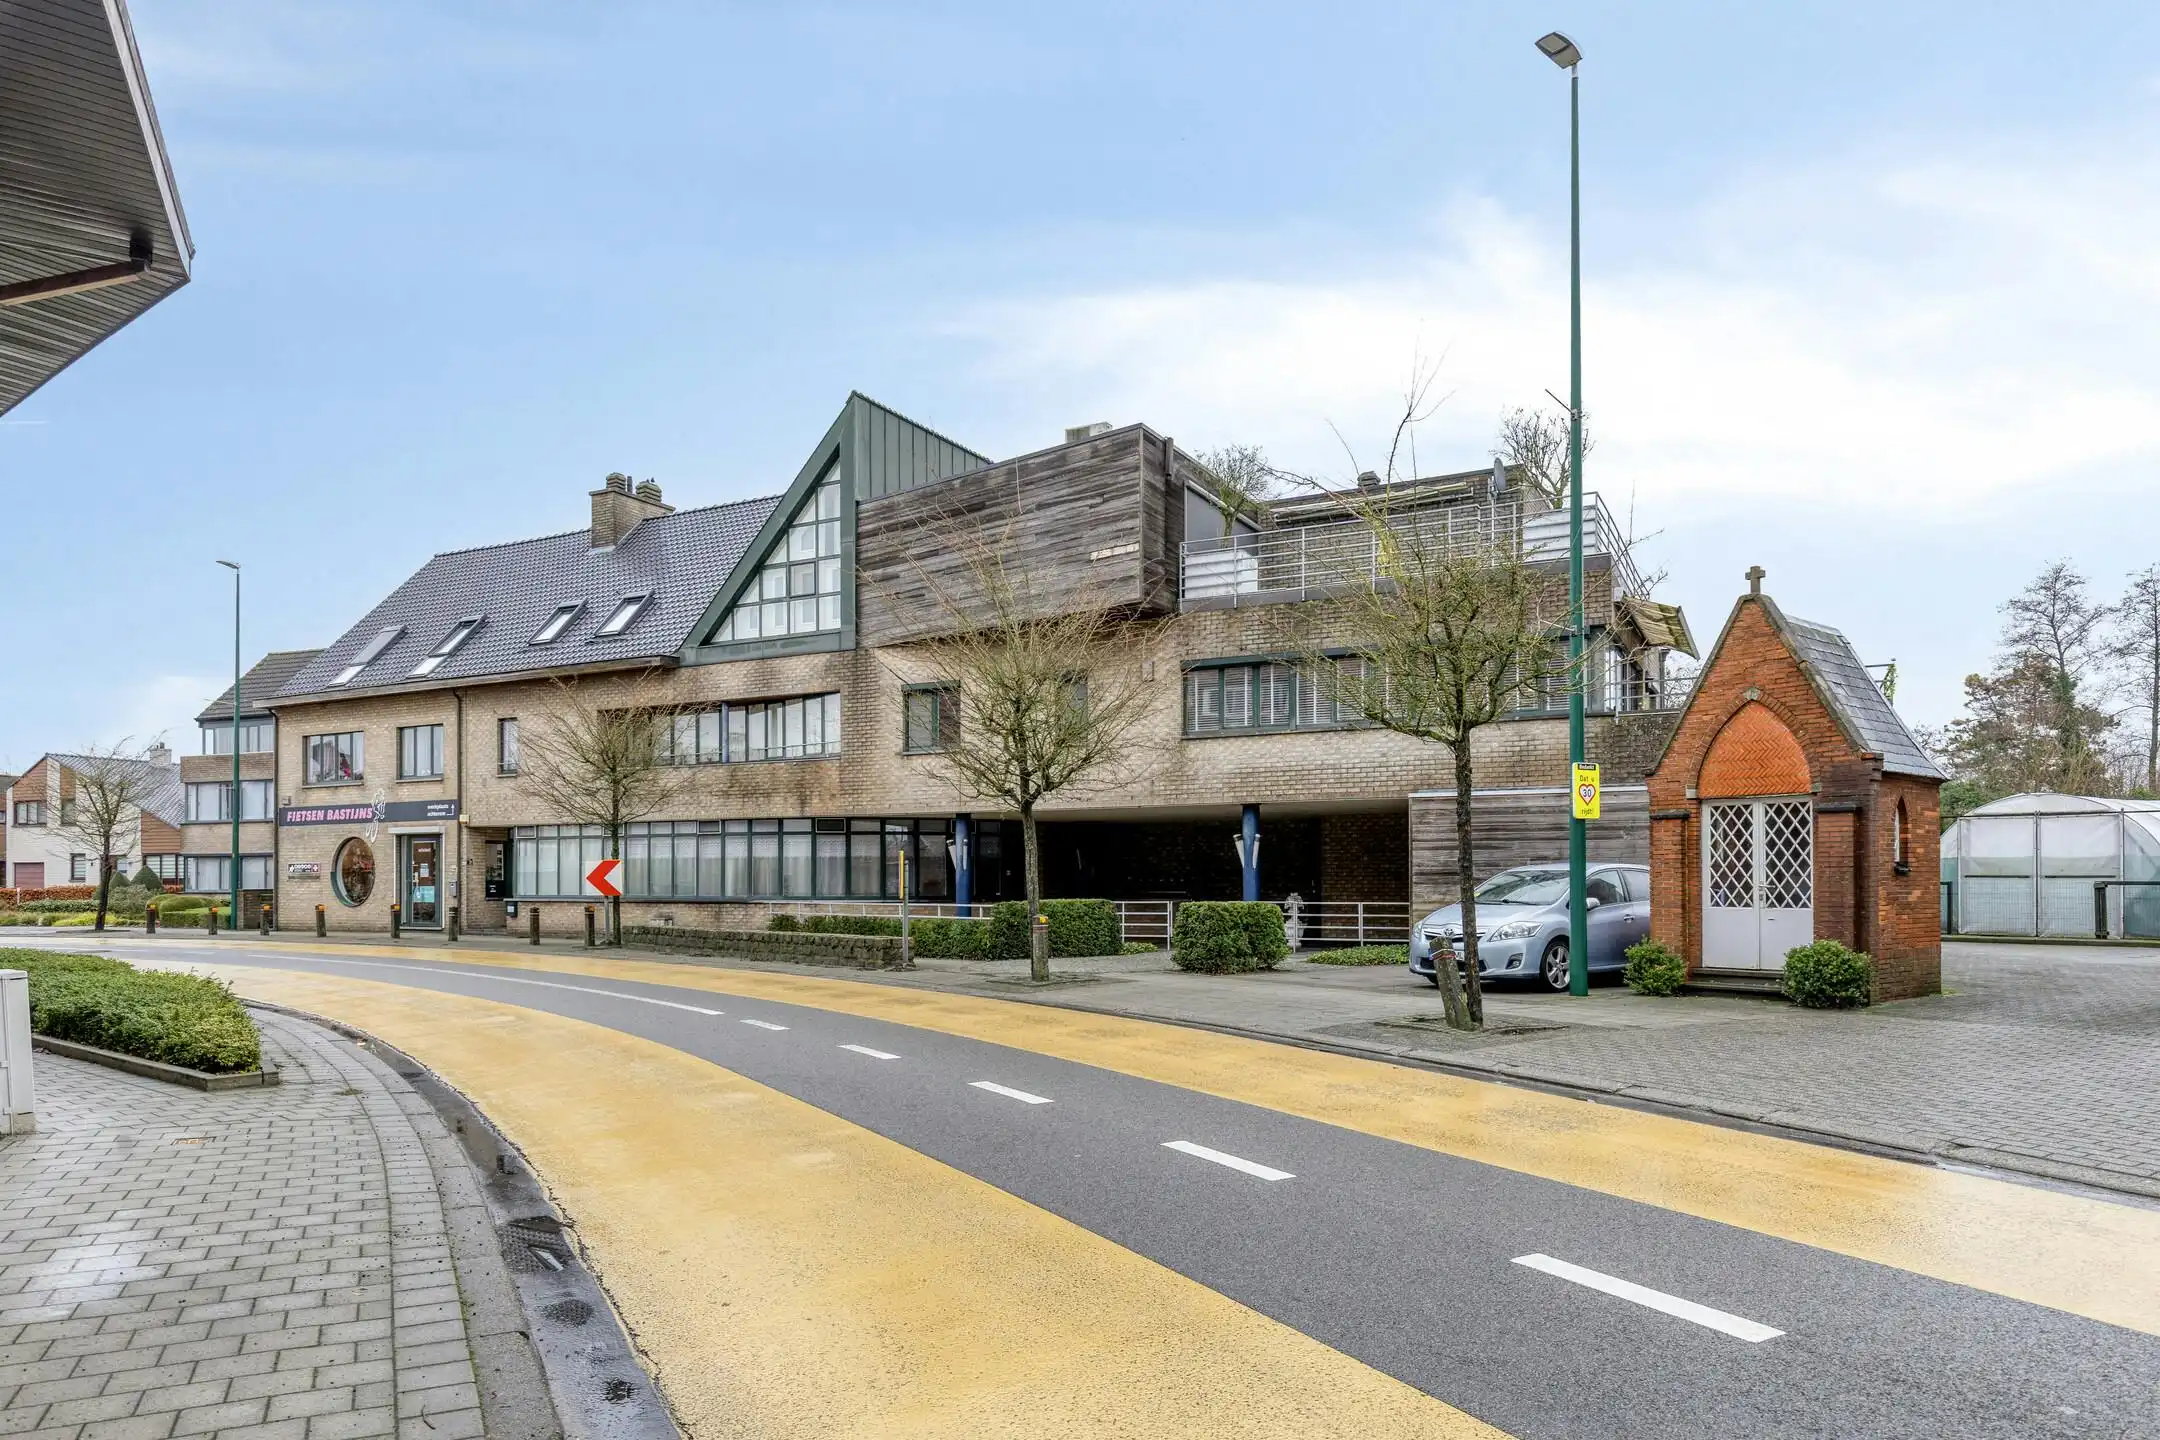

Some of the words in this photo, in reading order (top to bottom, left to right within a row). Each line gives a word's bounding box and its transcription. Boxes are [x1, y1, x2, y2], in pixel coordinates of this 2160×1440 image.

[1583, 789, 1592, 797] 30
[287, 810, 324, 822] FIETSEN
[326, 808, 373, 820] BASTIJNS
